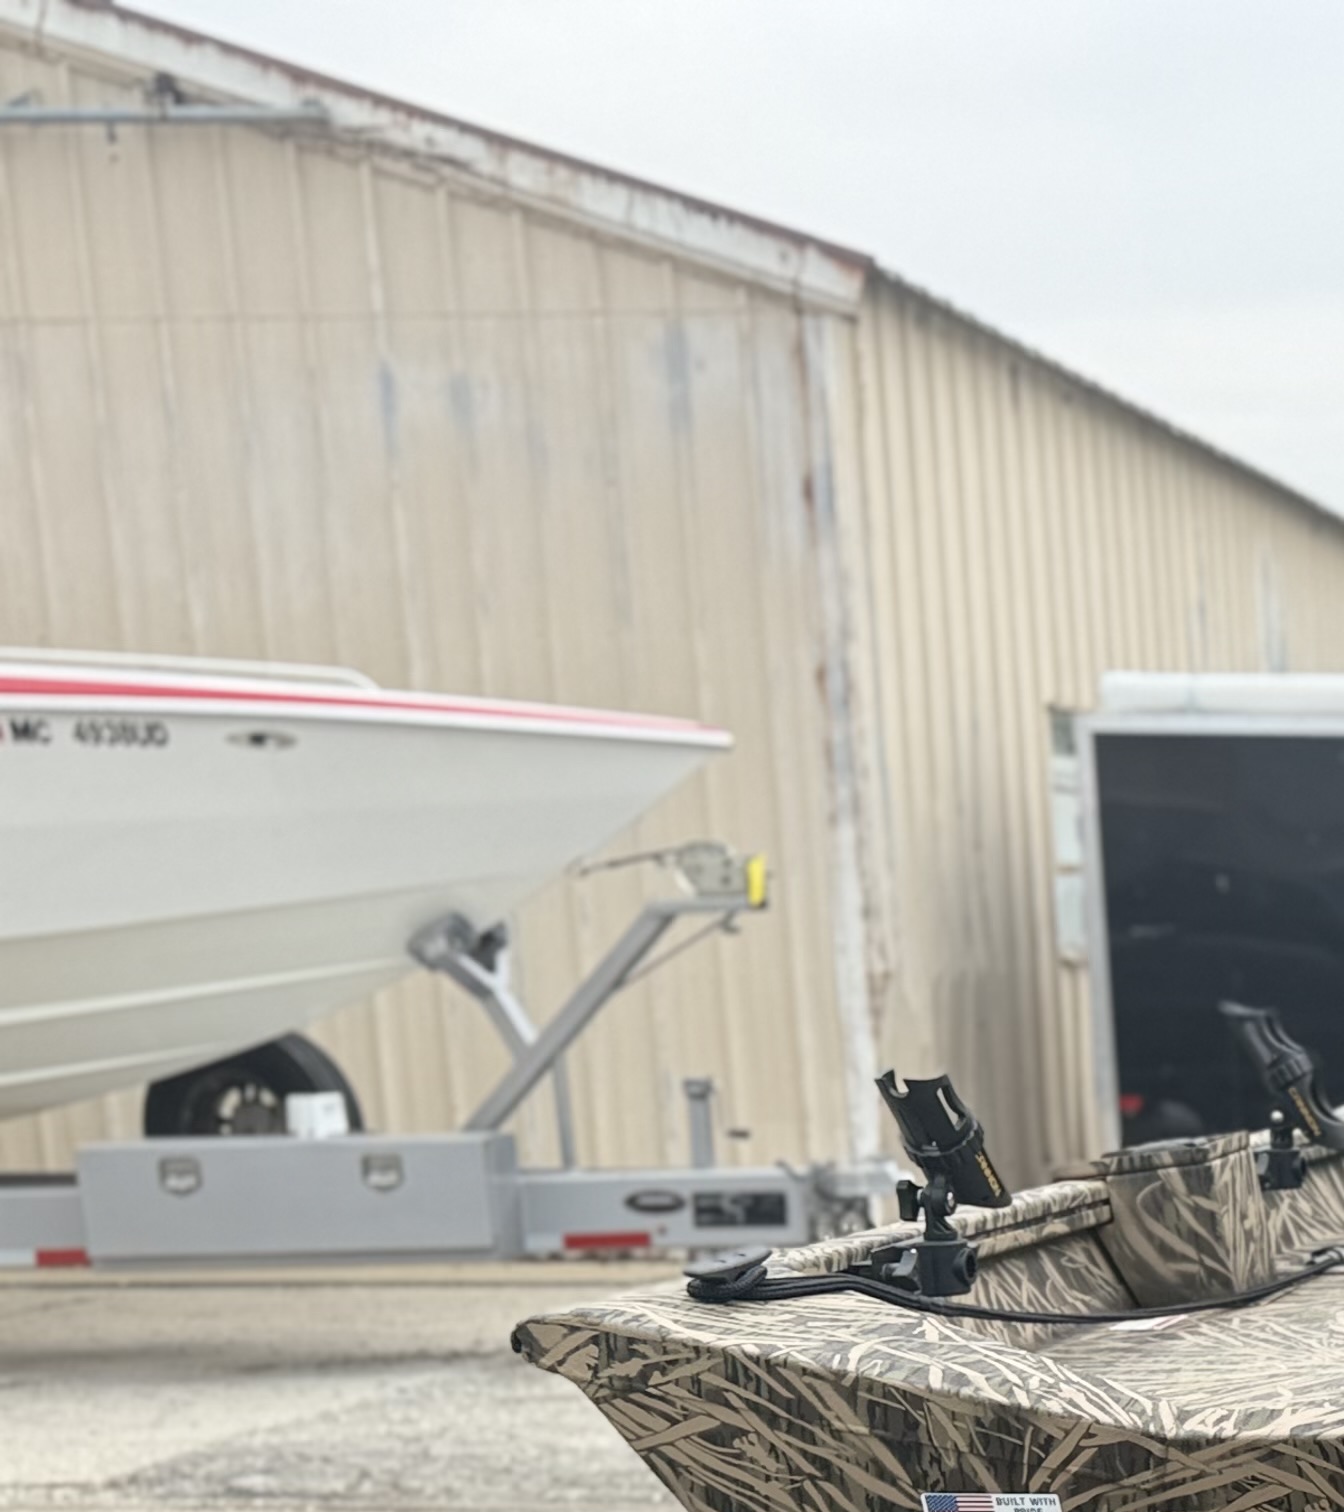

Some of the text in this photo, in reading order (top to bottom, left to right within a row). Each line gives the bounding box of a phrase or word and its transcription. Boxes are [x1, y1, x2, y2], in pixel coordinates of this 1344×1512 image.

[9, 716, 52, 745] MC
[995, 1497, 1057, 1506] BUILT WITH
